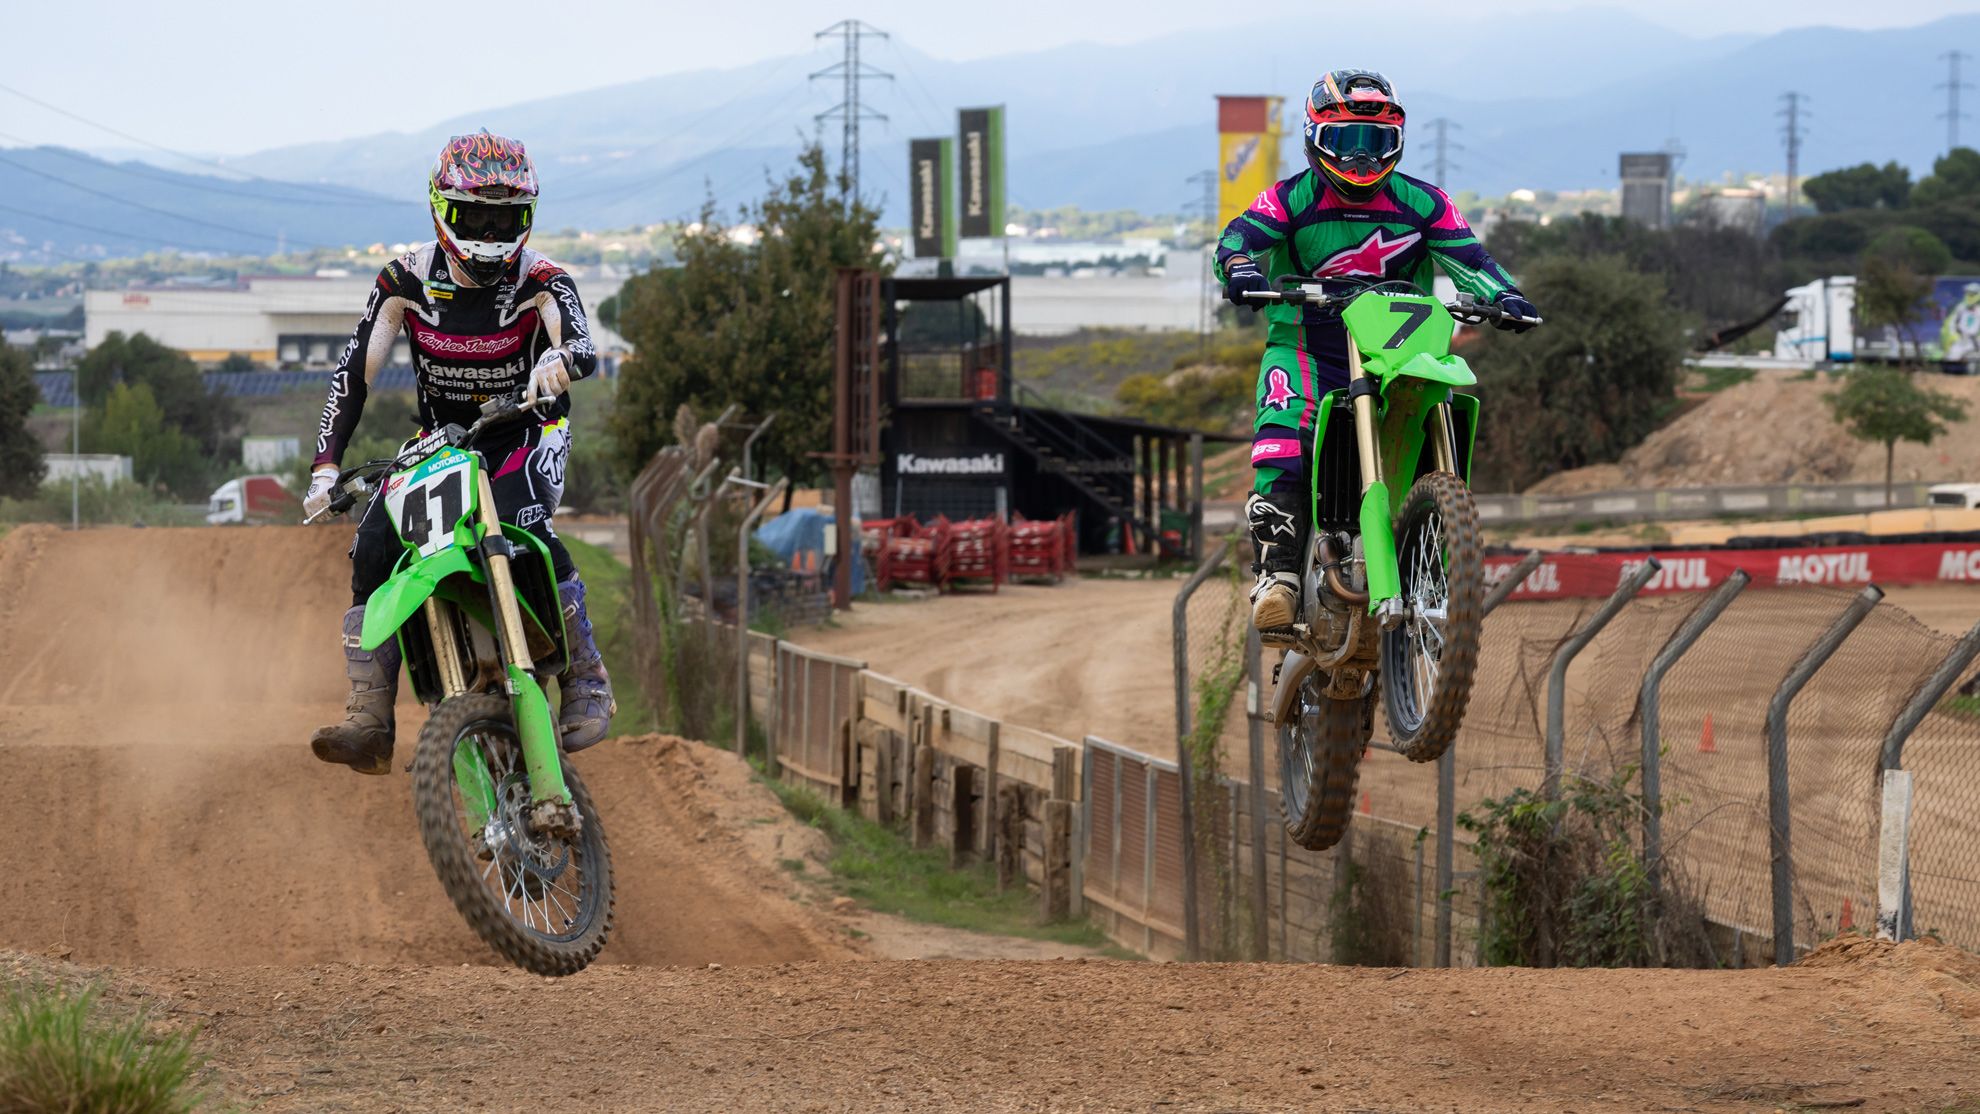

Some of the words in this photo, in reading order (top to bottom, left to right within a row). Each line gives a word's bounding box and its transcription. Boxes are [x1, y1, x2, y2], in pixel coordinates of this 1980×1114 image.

[965, 131, 982, 216] Kawasaki
[918, 159, 934, 239] Kawasaki
[1382, 301, 1433, 350] 7
[418, 353, 526, 380] Kawasaki
[428, 375, 475, 391] Racing
[476, 379, 516, 389] Team
[427, 453, 468, 473] MOTOREX
[897, 453, 1004, 473] Kawasaki
[400, 470, 463, 549] 41
[1776, 552, 1872, 584] MOTUL
